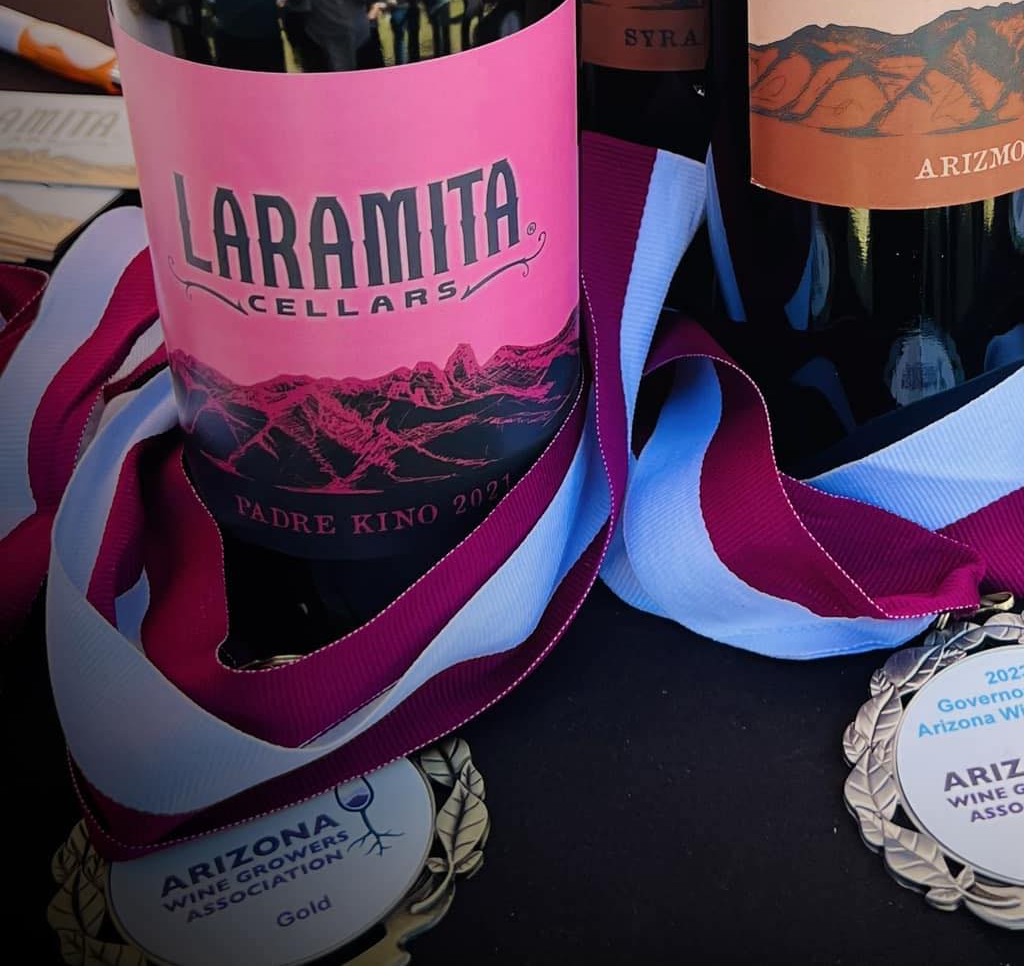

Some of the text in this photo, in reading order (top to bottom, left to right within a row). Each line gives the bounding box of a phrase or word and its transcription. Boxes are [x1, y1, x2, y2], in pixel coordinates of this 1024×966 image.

[172, 157, 521, 290] LARAMITA
[247, 279, 457, 318] CELLARS
[232, 493, 337, 536] PADRE
[351, 502, 440, 537] KINO
[916, 713, 997, 739] Arizona
[946, 786, 1009, 811] WINE
[159, 814, 342, 898] ARIZONA
[162, 830, 350, 914] WINE GROWERS
[185, 850, 344, 924] ASSOCIATION
[275, 895, 332, 929] Gold
